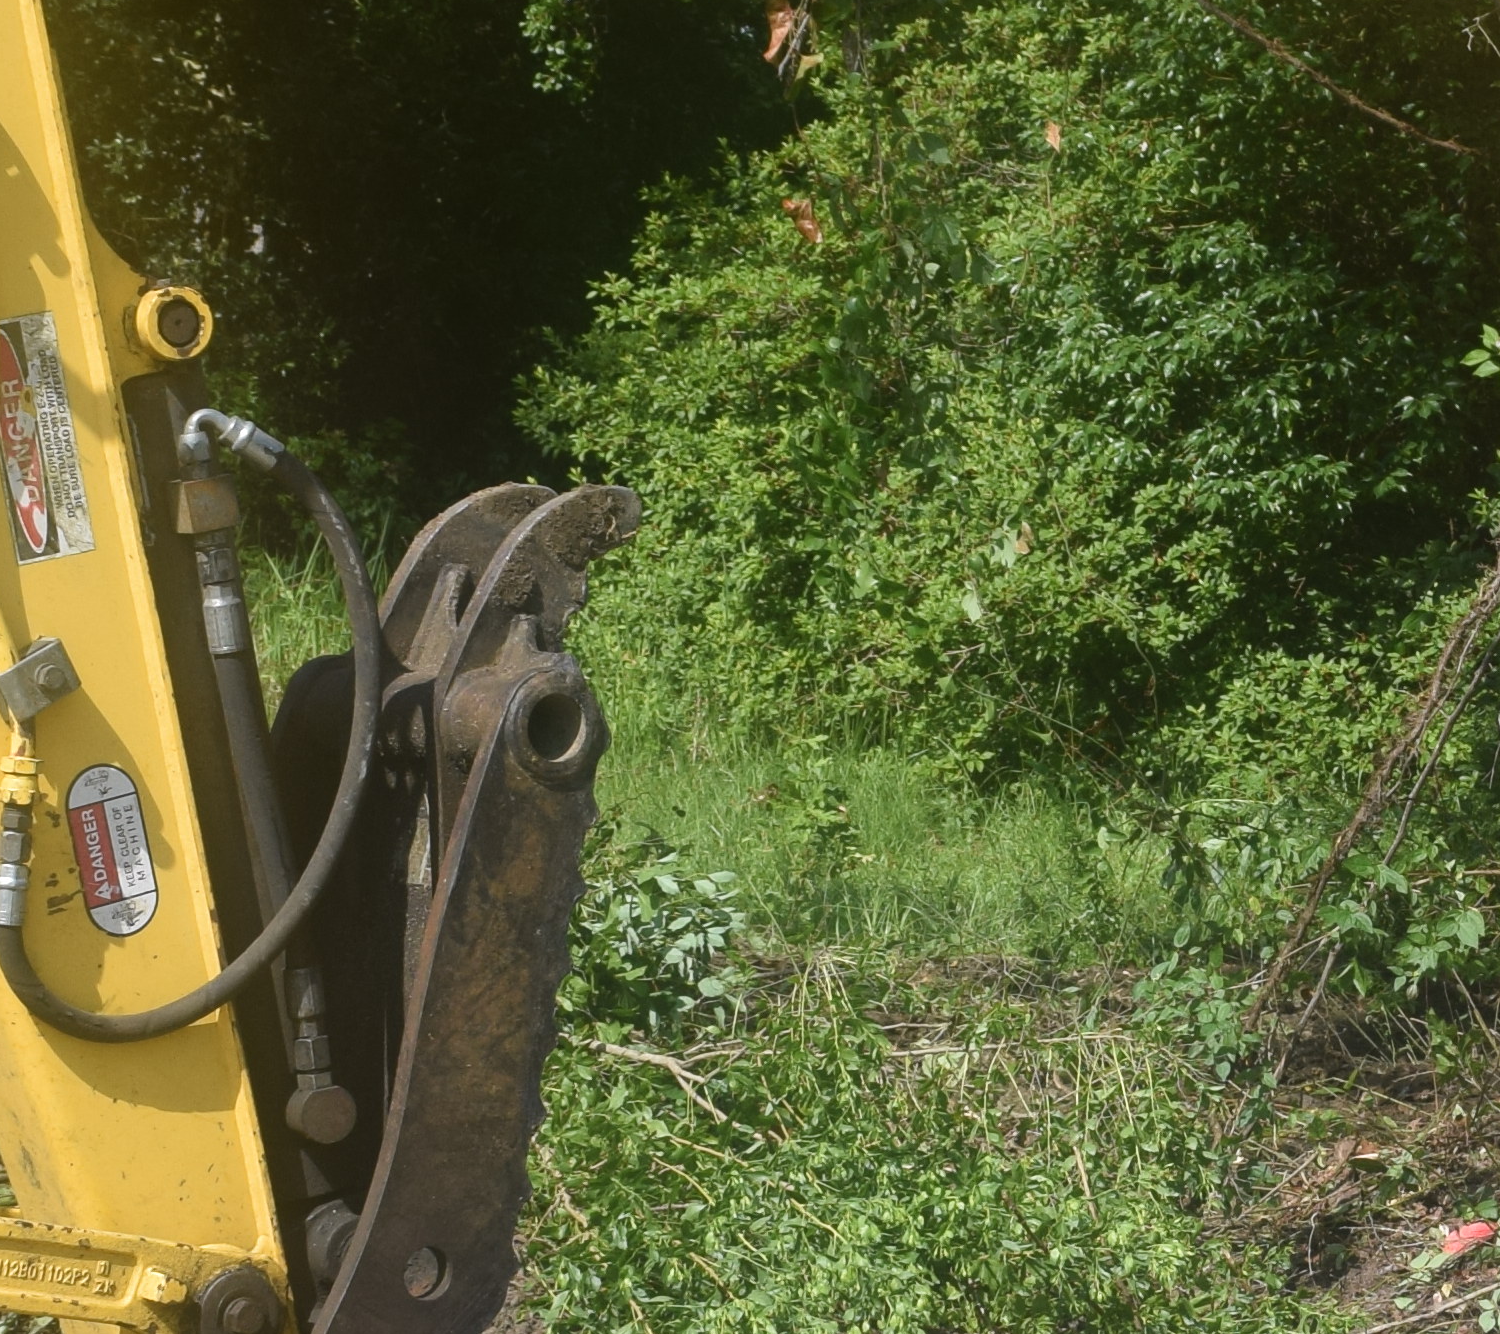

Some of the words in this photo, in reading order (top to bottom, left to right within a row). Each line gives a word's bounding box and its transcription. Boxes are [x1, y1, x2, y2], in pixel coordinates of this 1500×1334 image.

[44, 381, 56, 409] WITH
[1, 379, 40, 502] DANGER
[40, 411, 57, 473] OPERATING
[49, 410, 67, 475] TRANSPORT
[62, 429, 74, 458] LOAD
[60, 477, 71, 500] NOT
[65, 501, 75, 518] DO
[112, 807, 122, 820] OF
[81, 809, 107, 882] DANGER
[116, 824, 129, 857] CLEAR
[123, 805, 146, 881] MACHINE
[124, 862, 136, 887] KEEP
